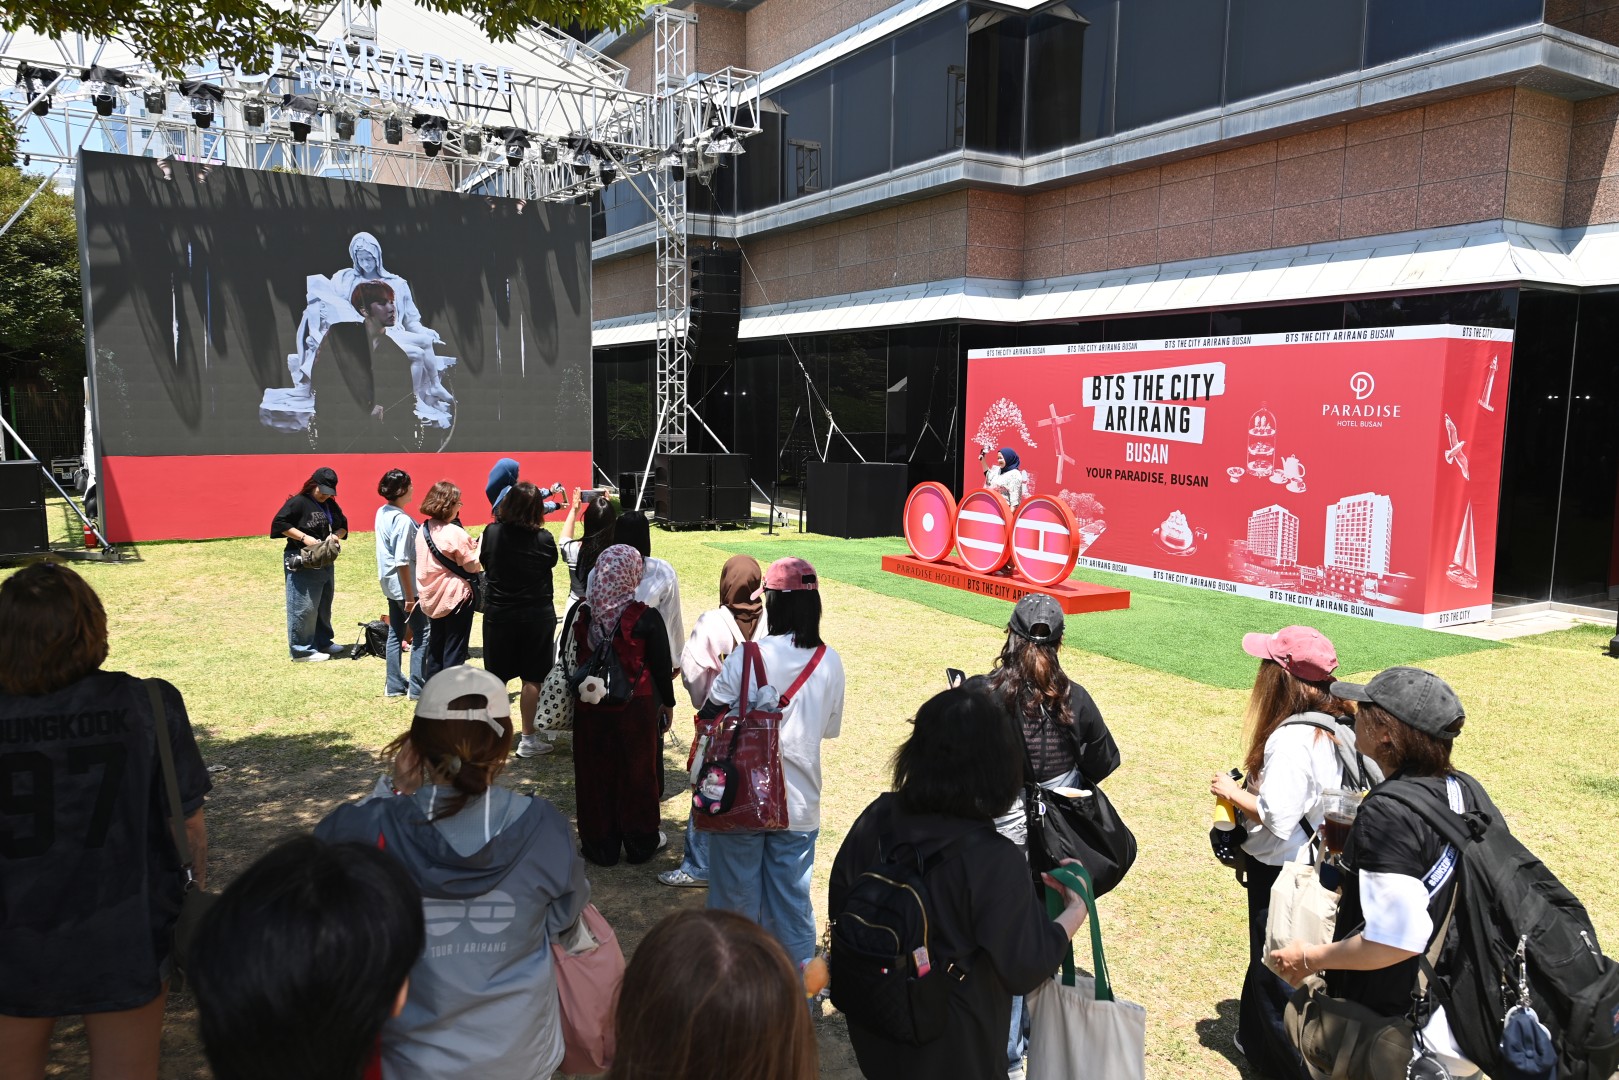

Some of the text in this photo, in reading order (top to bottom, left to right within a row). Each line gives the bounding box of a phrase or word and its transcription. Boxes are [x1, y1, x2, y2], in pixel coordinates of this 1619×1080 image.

[300, 69, 452, 111] HOTEL BUSAN
[1286, 329, 1395, 343] BTS THE CITY ARIRANG BUSAN
[1463, 327, 1493, 338] BTS THE CITY
[1067, 342, 1138, 353] BTS THE CITY ARIRANG BUSAN
[1165, 336, 1252, 349] BTS THE CITY ARIRANG BUSAN
[1013, 348, 1031, 356] ARIRANG
[1032, 347, 1046, 355] BUSAN
[1092, 374, 1215, 401] BTS THE CITY
[1322, 404, 1401, 418] PARADISE
[1105, 406, 1191, 434] ARIRANG
[1337, 420, 1358, 428] HOTEL
[1126, 442, 1169, 465] BUSAN
[1086, 467, 1209, 488] YOUR PARADISE, BUSAN
[1078, 558, 1128, 573] CITY ARIRANG BUSAN
[897, 564, 932, 580] PARADISE
[936, 572, 961, 587] HOTEL
[968, 578, 980, 592] BTS
[983, 581, 994, 594] THE
[995, 584, 1010, 599] CITY
[1154, 571, 1237, 593] BTS THE CITY ARIRANG BUSAN
[1270, 590, 1374, 618] BTS THE CITY ARIRANG BUSAN
[1439, 609, 1471, 624] BTS THE CITY
[0, 743, 128, 859] 97
[431, 942, 507, 958] TOUR ARIRANG
